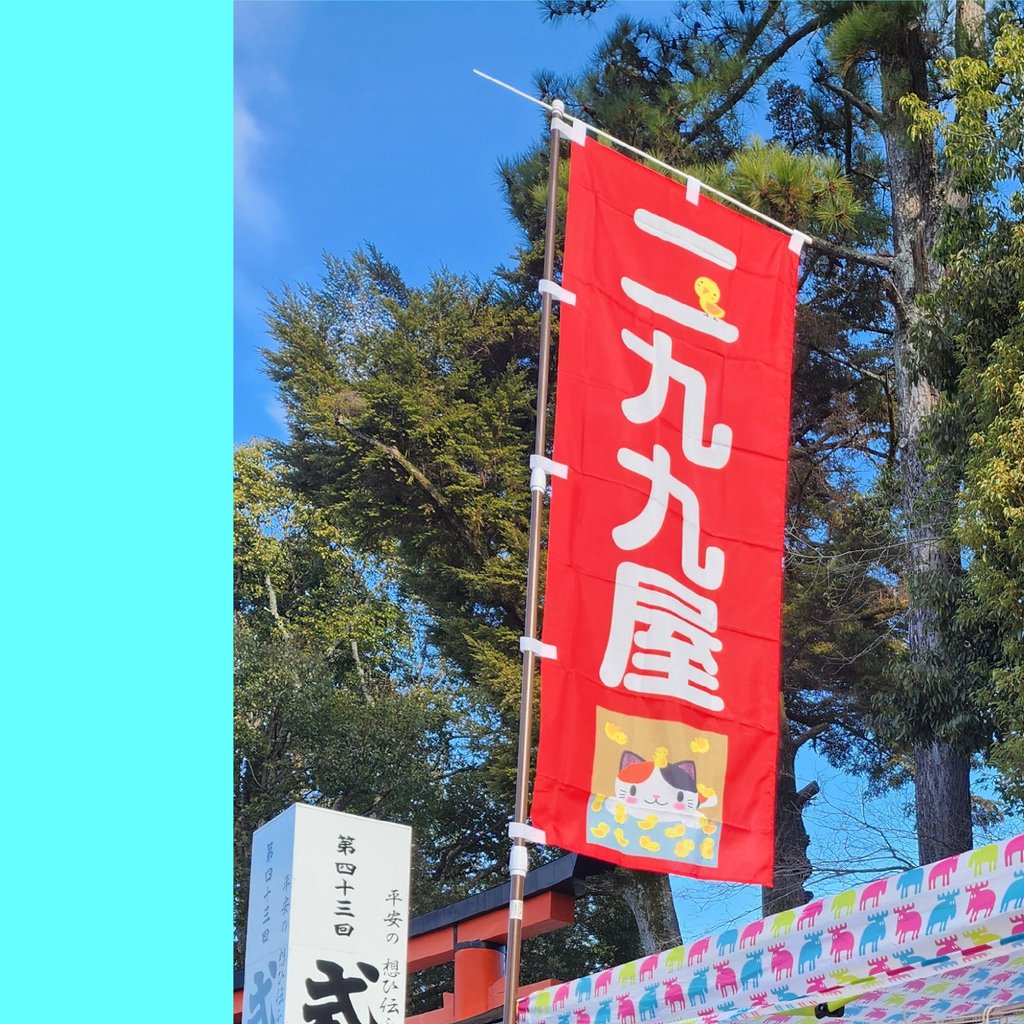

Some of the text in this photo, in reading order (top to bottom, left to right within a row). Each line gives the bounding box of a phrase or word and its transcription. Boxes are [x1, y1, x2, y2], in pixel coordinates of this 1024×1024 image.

[333, 834, 357, 937] 第四十三回
[384, 889, 403, 945] 平安の
